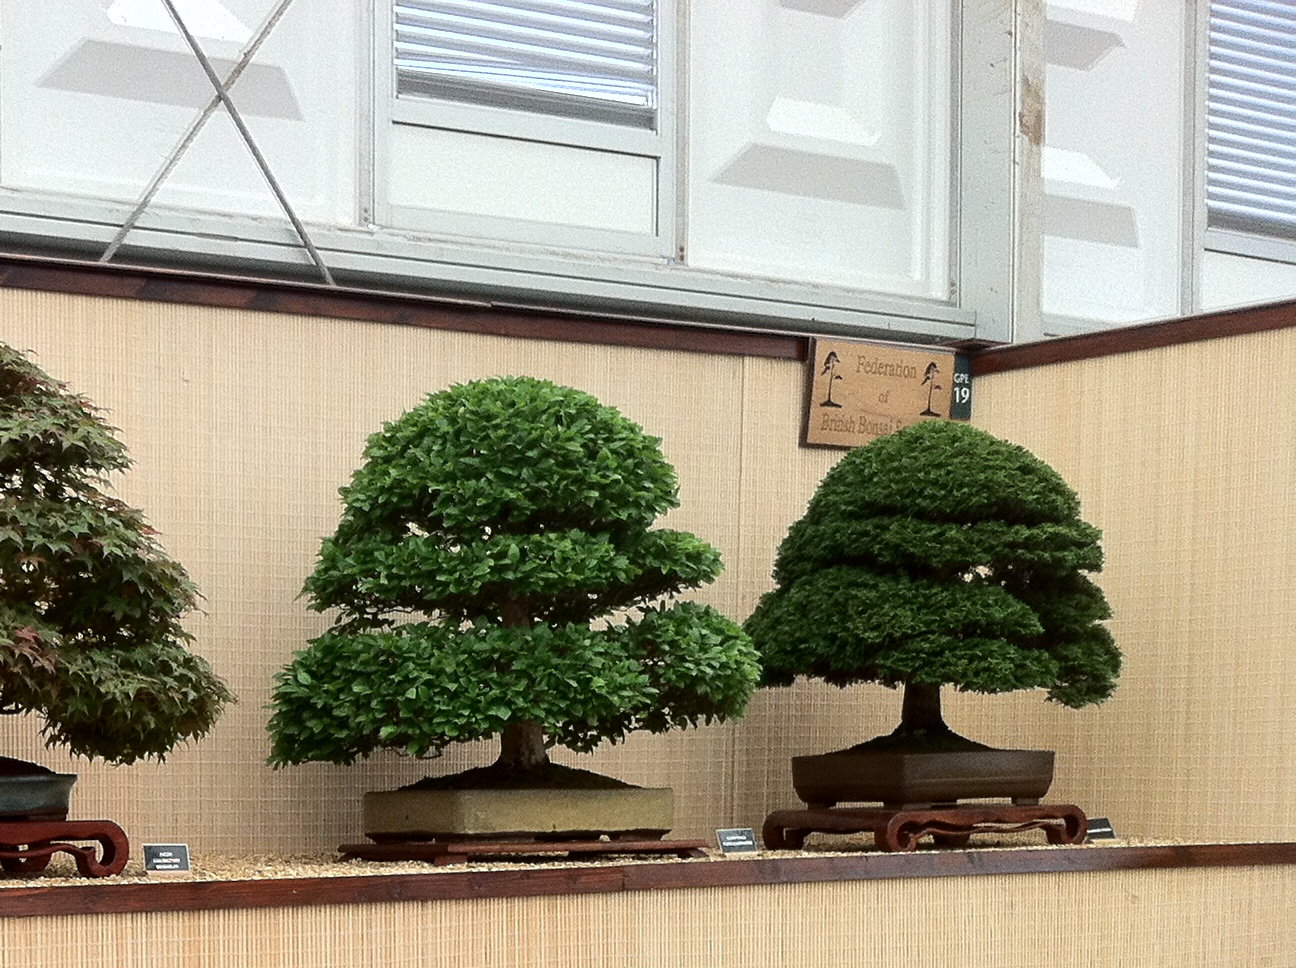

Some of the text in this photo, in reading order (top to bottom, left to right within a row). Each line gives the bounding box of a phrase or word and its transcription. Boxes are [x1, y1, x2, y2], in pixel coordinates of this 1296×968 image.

[856, 355, 918, 379] Federation
[954, 373, 970, 384] GPE
[878, 391, 889, 404] of
[954, 387, 970, 404] 19
